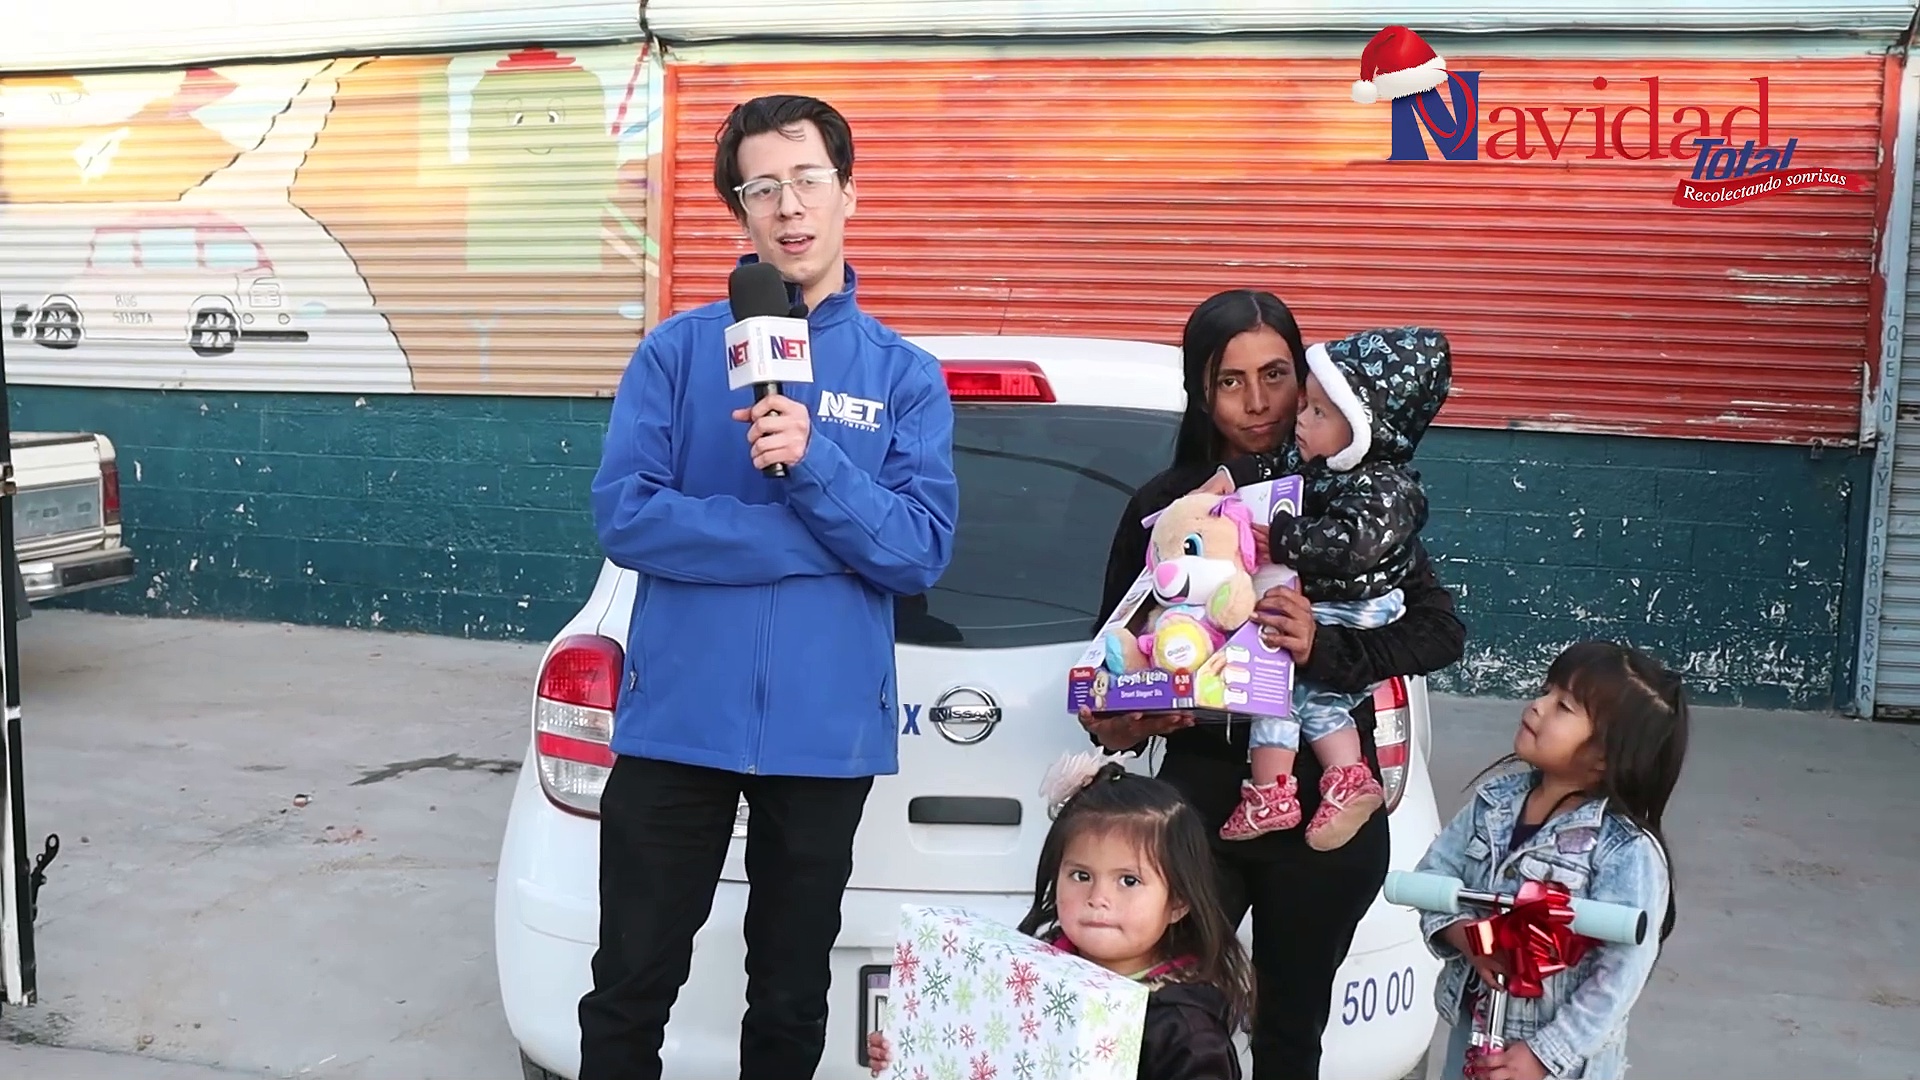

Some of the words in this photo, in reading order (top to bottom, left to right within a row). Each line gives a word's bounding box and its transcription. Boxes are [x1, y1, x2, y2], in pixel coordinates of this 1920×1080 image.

[728, 340, 749, 371] NET
[770, 334, 807, 360] NET
[1886, 325, 1899, 378] QUE
[817, 390, 884, 425] NET
[1882, 389, 1893, 422] NO
[821, 416, 876, 433] MULTIMEDIA
[1876, 433, 1891, 508] VIVE
[1868, 517, 1884, 589] PARA
[1861, 597, 1877, 702] SERVIR
[936, 706, 998, 721] NISSAN
[1342, 977, 1377, 1026] 50
[1386, 966, 1414, 1016] 00
